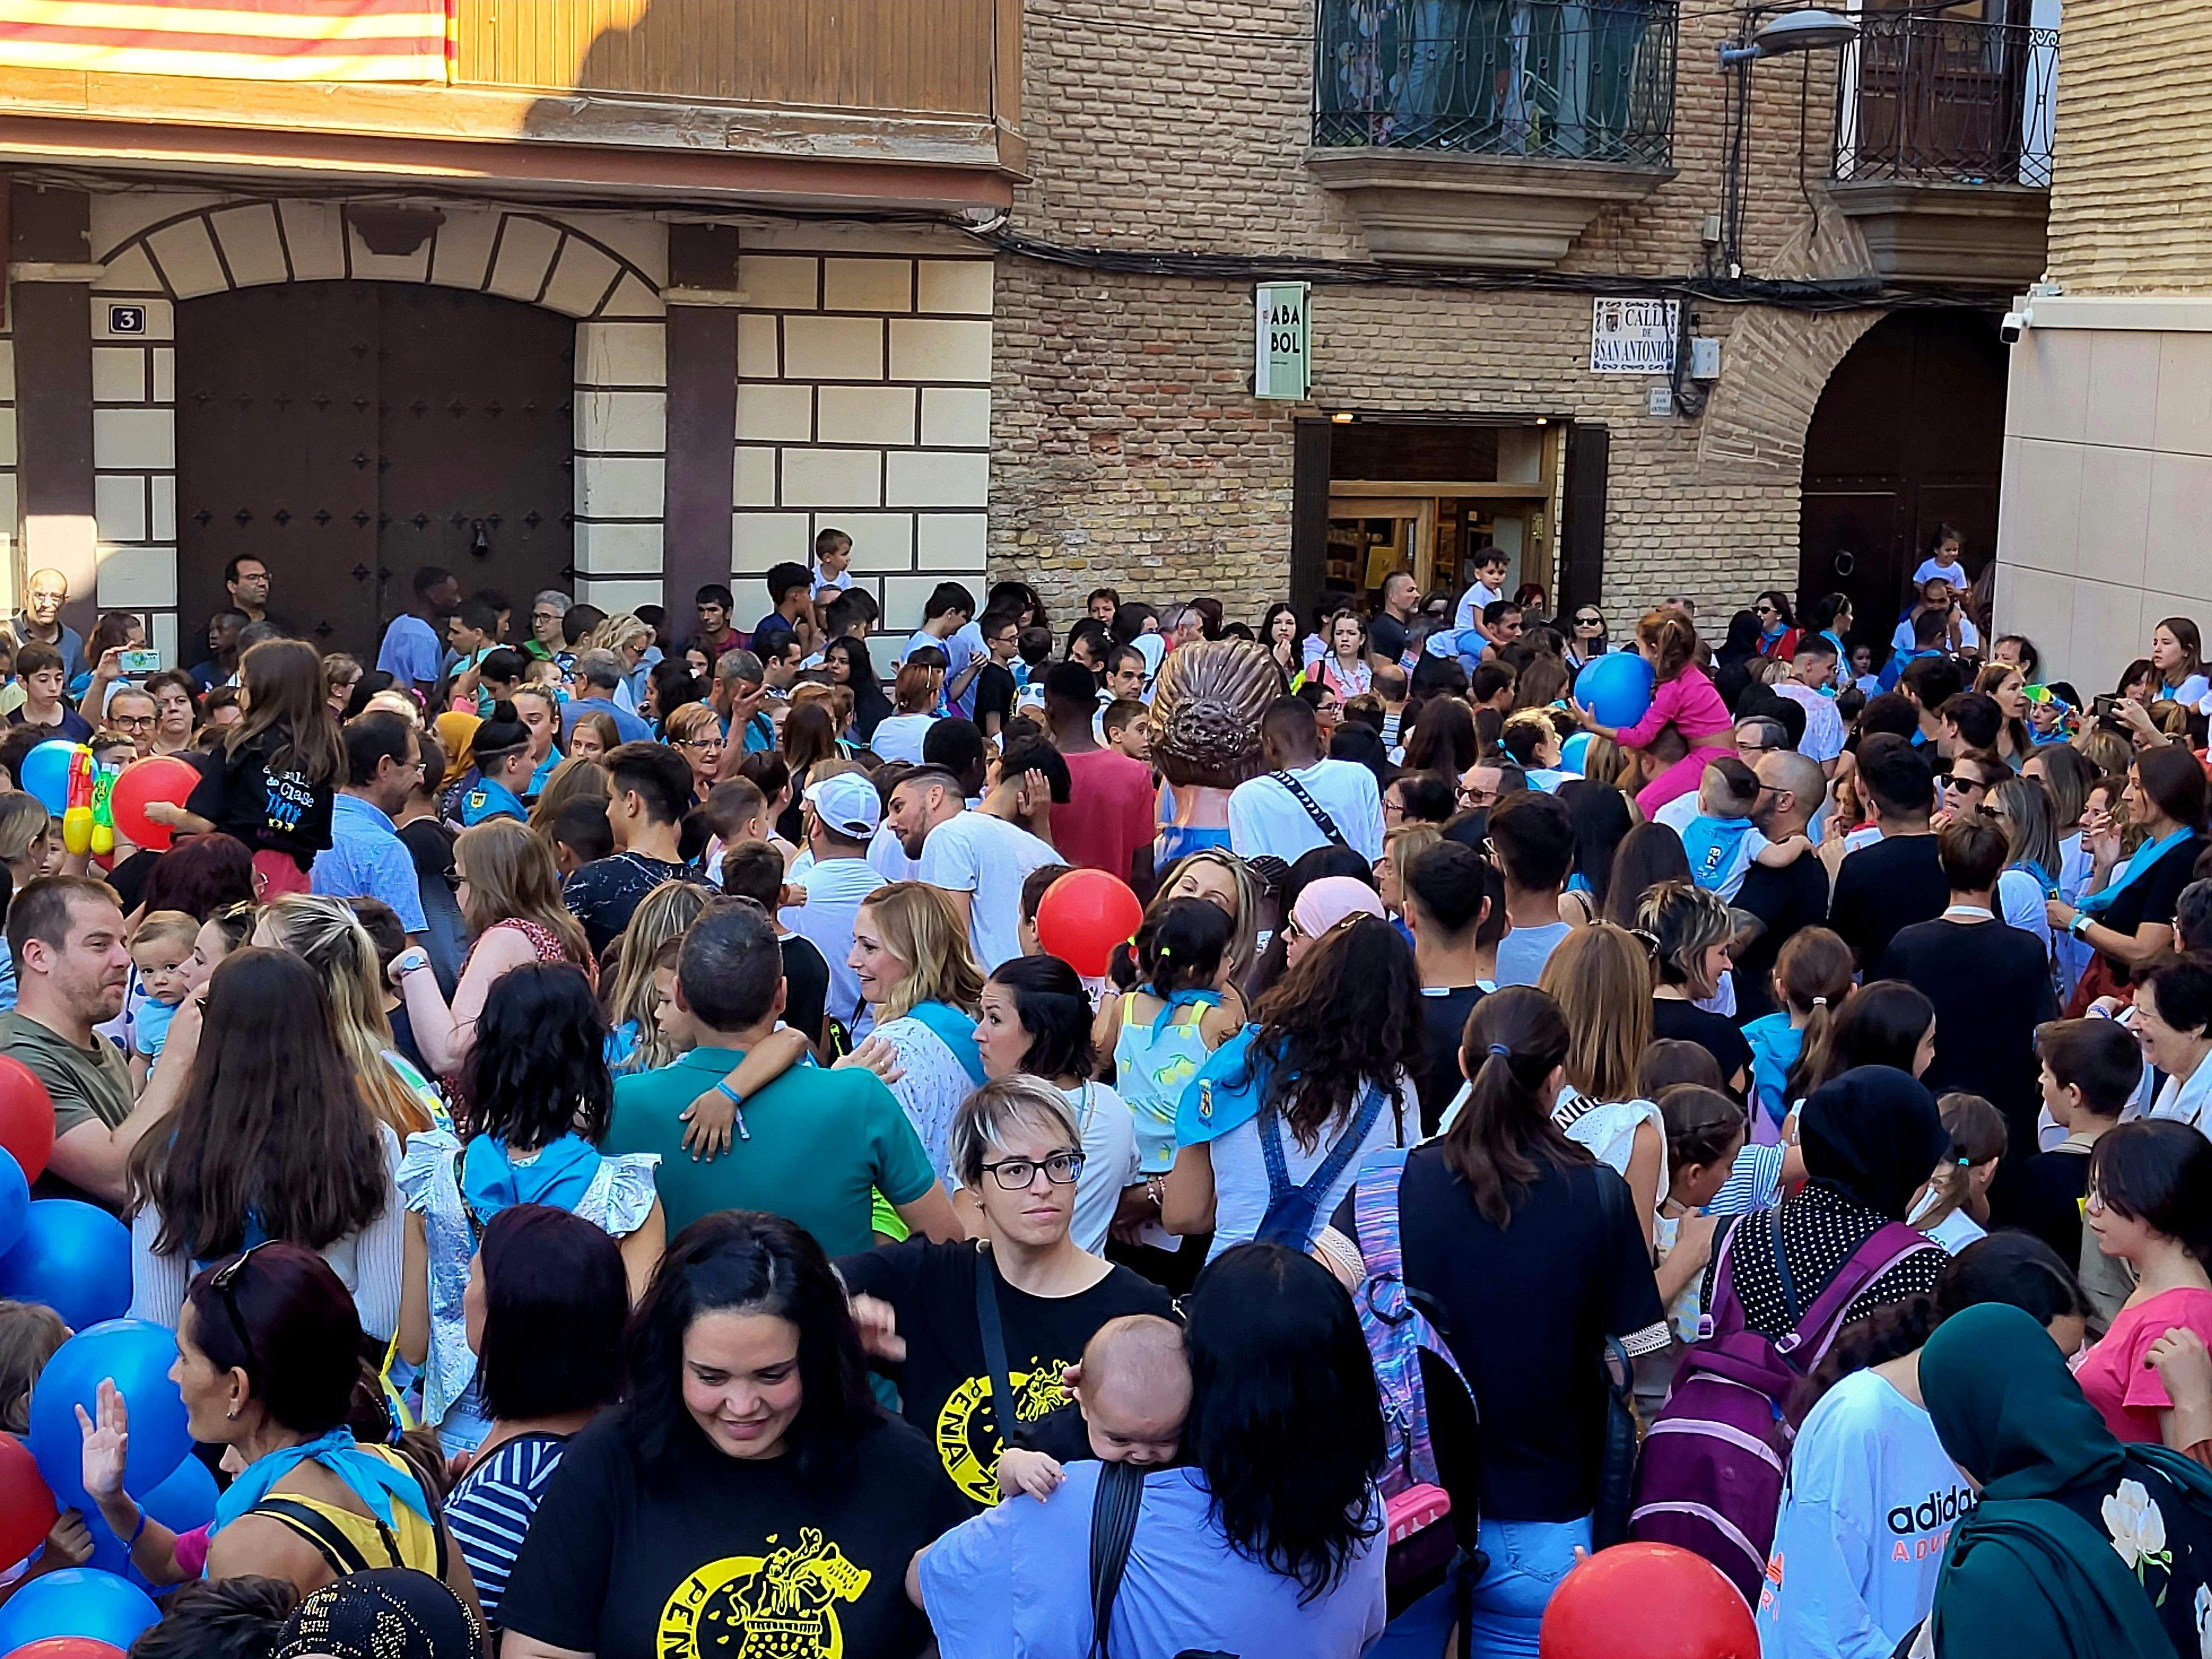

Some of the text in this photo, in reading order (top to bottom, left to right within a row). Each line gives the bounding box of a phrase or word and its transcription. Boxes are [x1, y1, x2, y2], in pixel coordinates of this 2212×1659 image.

[120, 311, 135, 328] 3
[1271, 305, 1300, 325] ABA
[1271, 332, 1300, 353] BOL
[1642, 328, 1651, 337] DE
[1599, 340, 1668, 362] SAN ANTONIO
